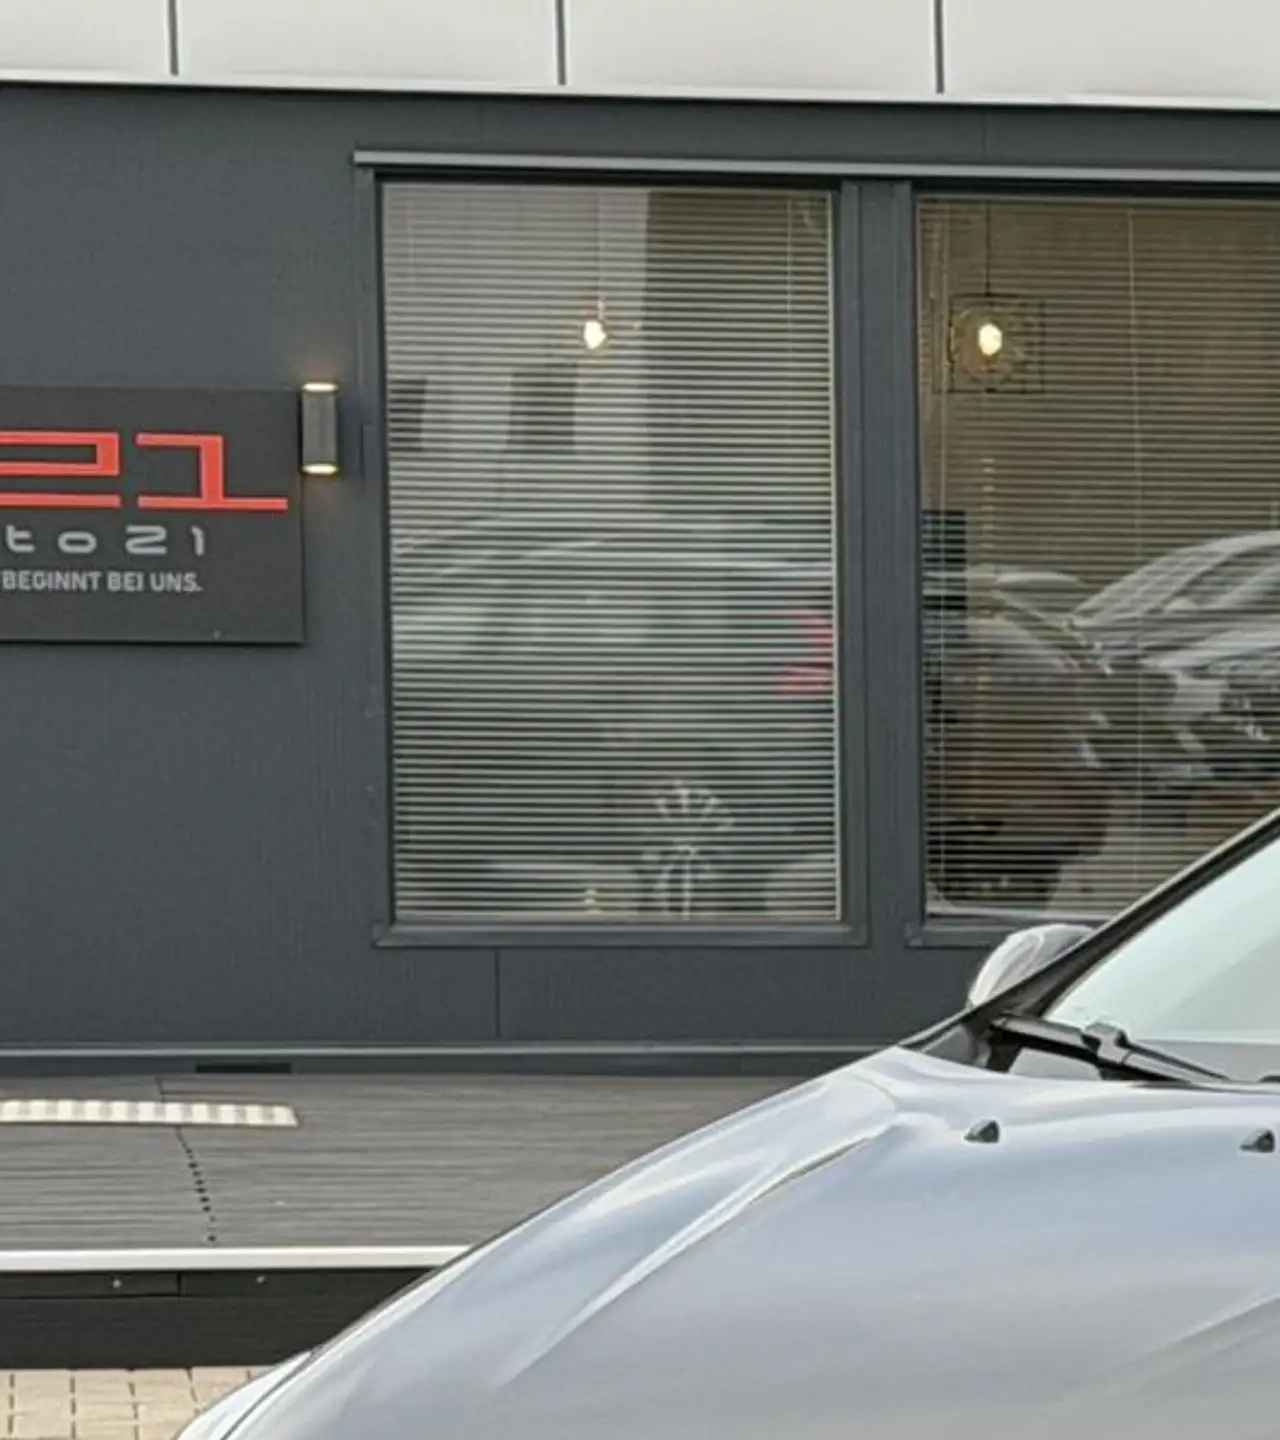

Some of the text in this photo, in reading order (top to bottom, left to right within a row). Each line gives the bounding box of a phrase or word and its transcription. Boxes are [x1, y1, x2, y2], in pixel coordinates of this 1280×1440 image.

[1, 569, 204, 593] BEGINNT BEI UNS.
